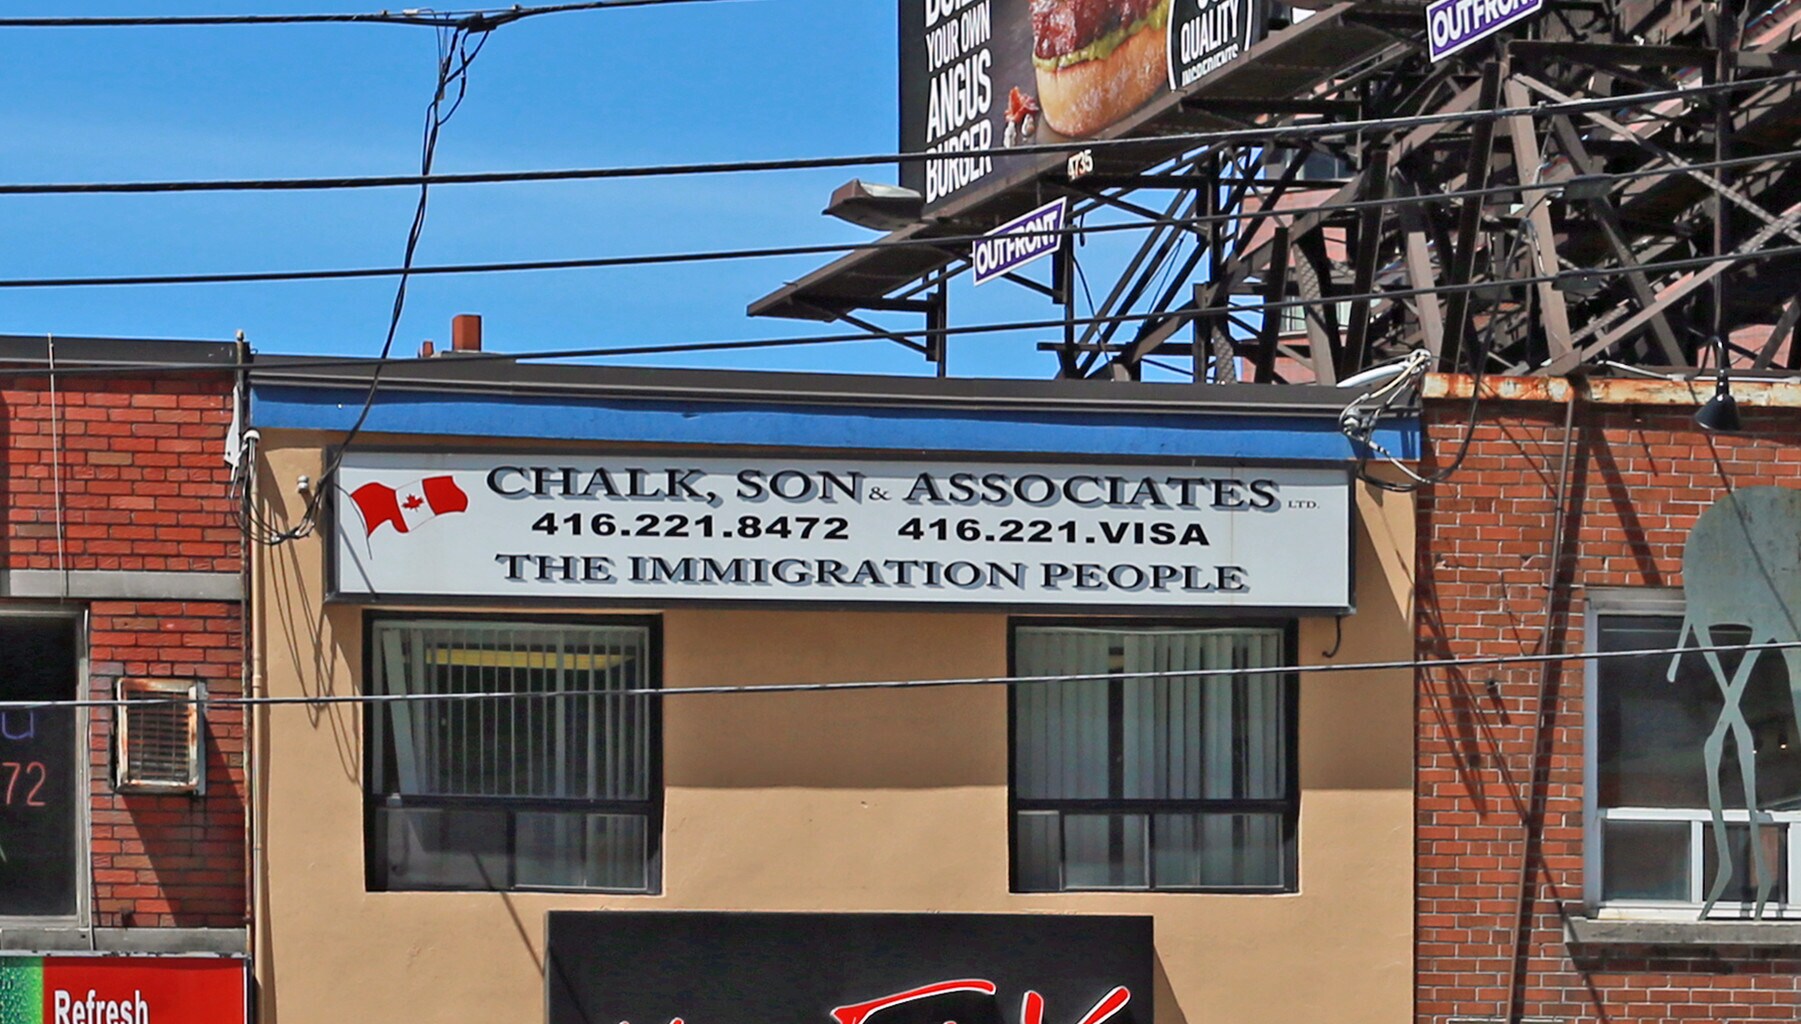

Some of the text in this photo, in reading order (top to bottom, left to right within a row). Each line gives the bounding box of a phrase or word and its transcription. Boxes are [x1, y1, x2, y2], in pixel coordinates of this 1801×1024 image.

[925, 18, 960, 73] YOUR
[960, 0, 991, 53] OWN
[1181, 0, 1240, 64] QUALITY
[1433, 0, 1533, 48] OUTFR
[926, 48, 992, 143] ANGUS
[926, 119, 992, 204] BURGER
[1067, 149, 1093, 180] 4735
[976, 210, 1058, 275] OUTFRONT
[486, 466, 1320, 512] CHALK, SON & ASSOCIATES LTD.
[531, 512, 1210, 546] 416.221.8472 416.221.VISA
[495, 553, 1251, 593] THE IMMIGRATION PEOPLE
